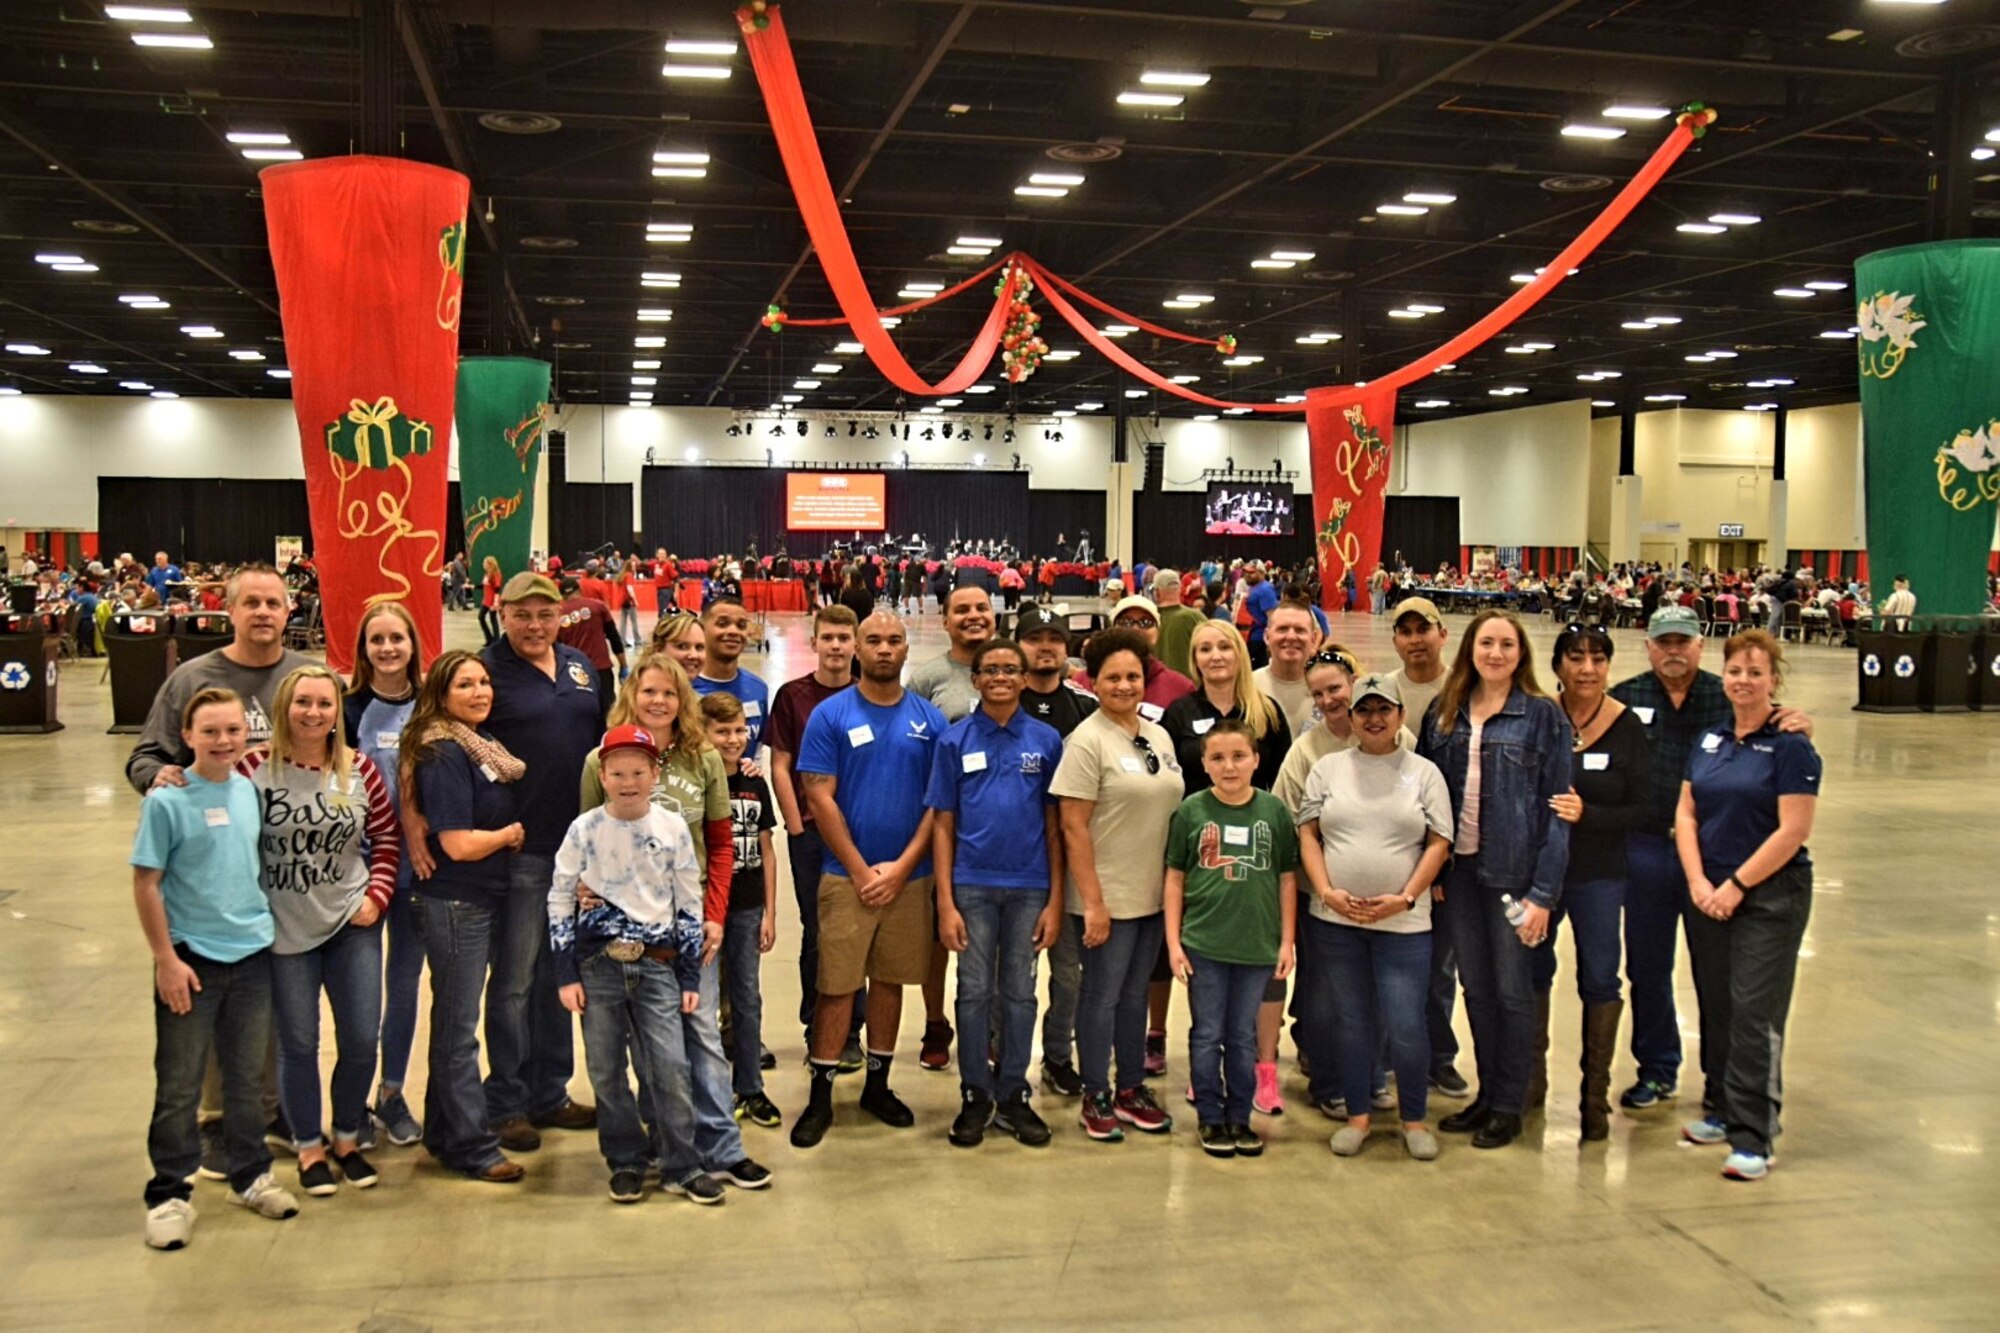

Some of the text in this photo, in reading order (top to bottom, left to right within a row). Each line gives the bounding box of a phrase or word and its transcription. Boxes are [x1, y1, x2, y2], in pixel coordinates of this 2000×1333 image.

[264, 787, 357, 837] Baby
[291, 822, 348, 856] cold
[265, 857, 344, 895] outside
